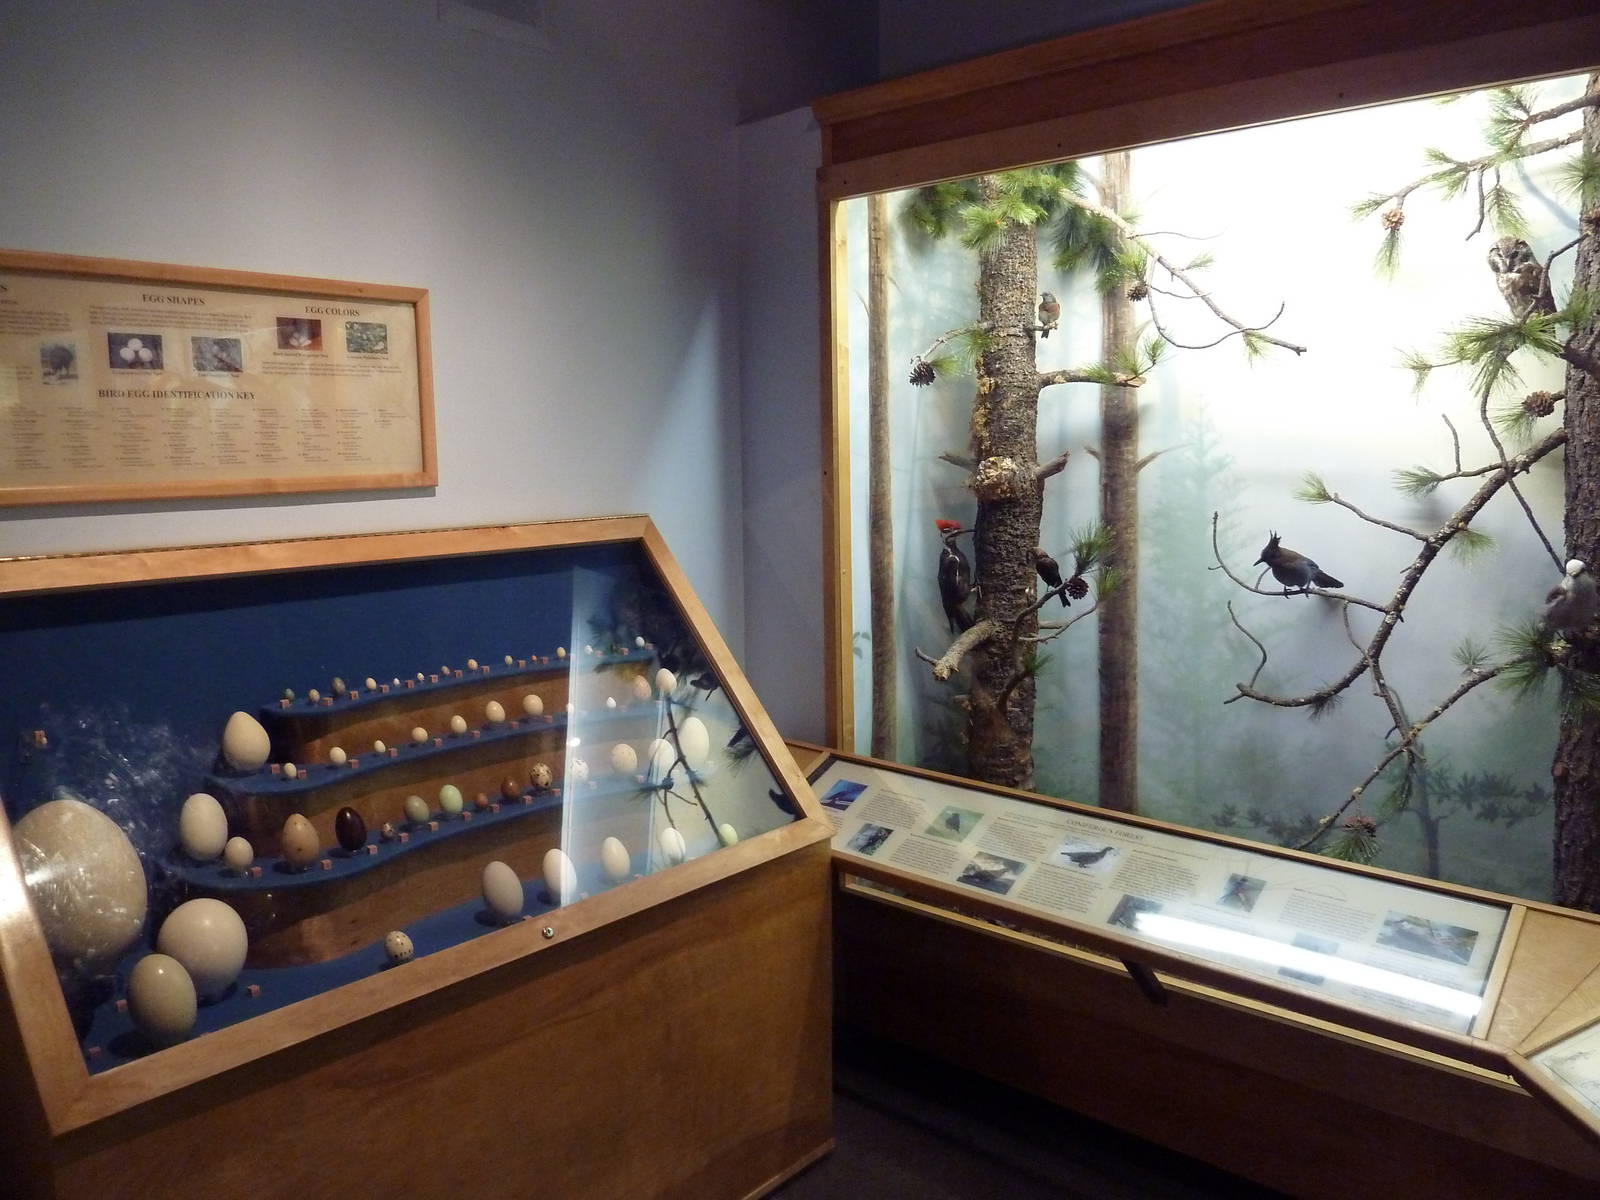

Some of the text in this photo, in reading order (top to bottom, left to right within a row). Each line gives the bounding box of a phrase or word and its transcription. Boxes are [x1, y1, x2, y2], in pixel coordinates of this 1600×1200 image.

[142, 294, 206, 305] EGG SHAPES
[305, 305, 361, 317] EGG COLORS
[127, 390, 150, 399] EGG
[152, 390, 235, 400] IDENTIFICATION
[236, 391, 256, 400] KEY
